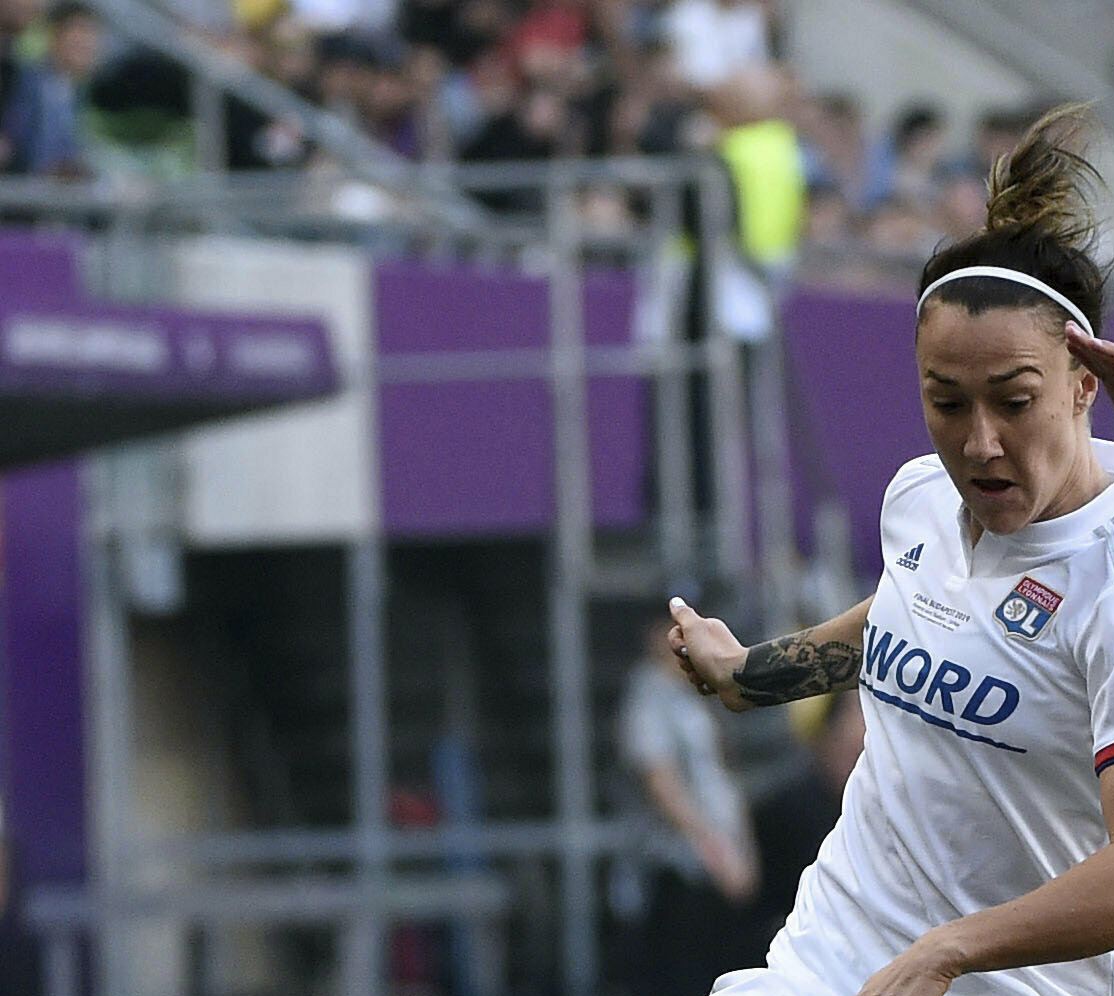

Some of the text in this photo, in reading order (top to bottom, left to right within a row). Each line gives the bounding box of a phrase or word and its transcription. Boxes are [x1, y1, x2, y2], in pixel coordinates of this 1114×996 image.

[1017, 585, 1054, 612] LYONNAIS
[1021, 579, 1060, 606] OLYMPIQUE
[864, 619, 1020, 726] WORD
